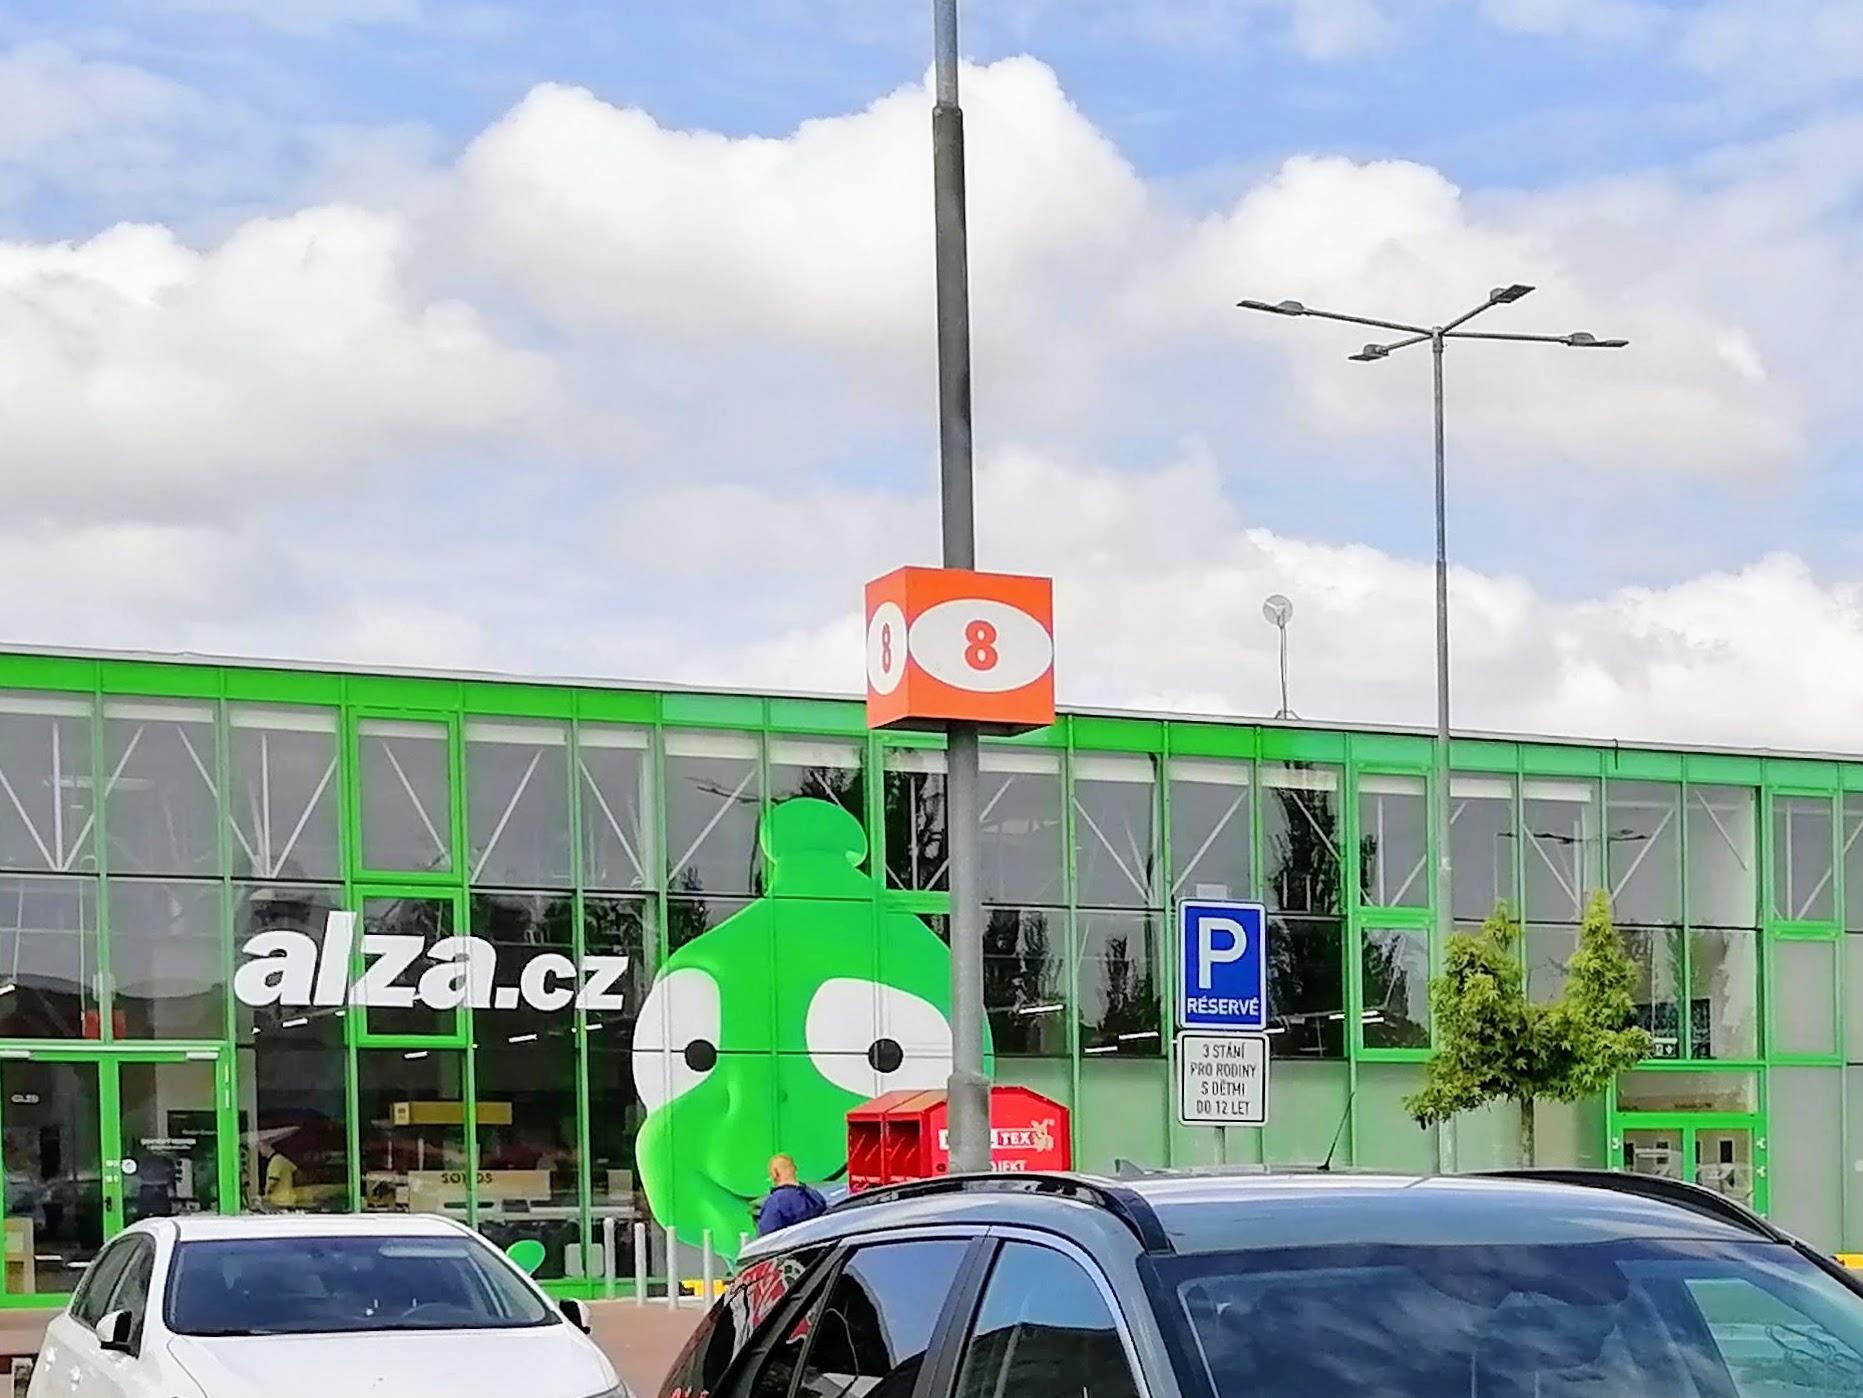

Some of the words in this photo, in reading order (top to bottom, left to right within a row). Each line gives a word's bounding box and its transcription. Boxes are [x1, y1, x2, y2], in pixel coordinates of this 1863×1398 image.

[882, 623, 891, 673] 8
[965, 620, 998, 671] 8
[234, 910, 629, 1011] alza.cz
[1198, 917, 1247, 989] P
[1187, 996, 1260, 1016] RÉSERVÉ
[1203, 1044, 1209, 1058] 3
[1190, 1062, 1213, 1076] PRO
[1216, 1063, 1256, 1078] RODINY
[1201, 1081, 1209, 1095] S
[1196, 1100, 1211, 1114] DO
[1216, 1100, 1227, 1115] 12
[1231, 1101, 1250, 1115] LET
